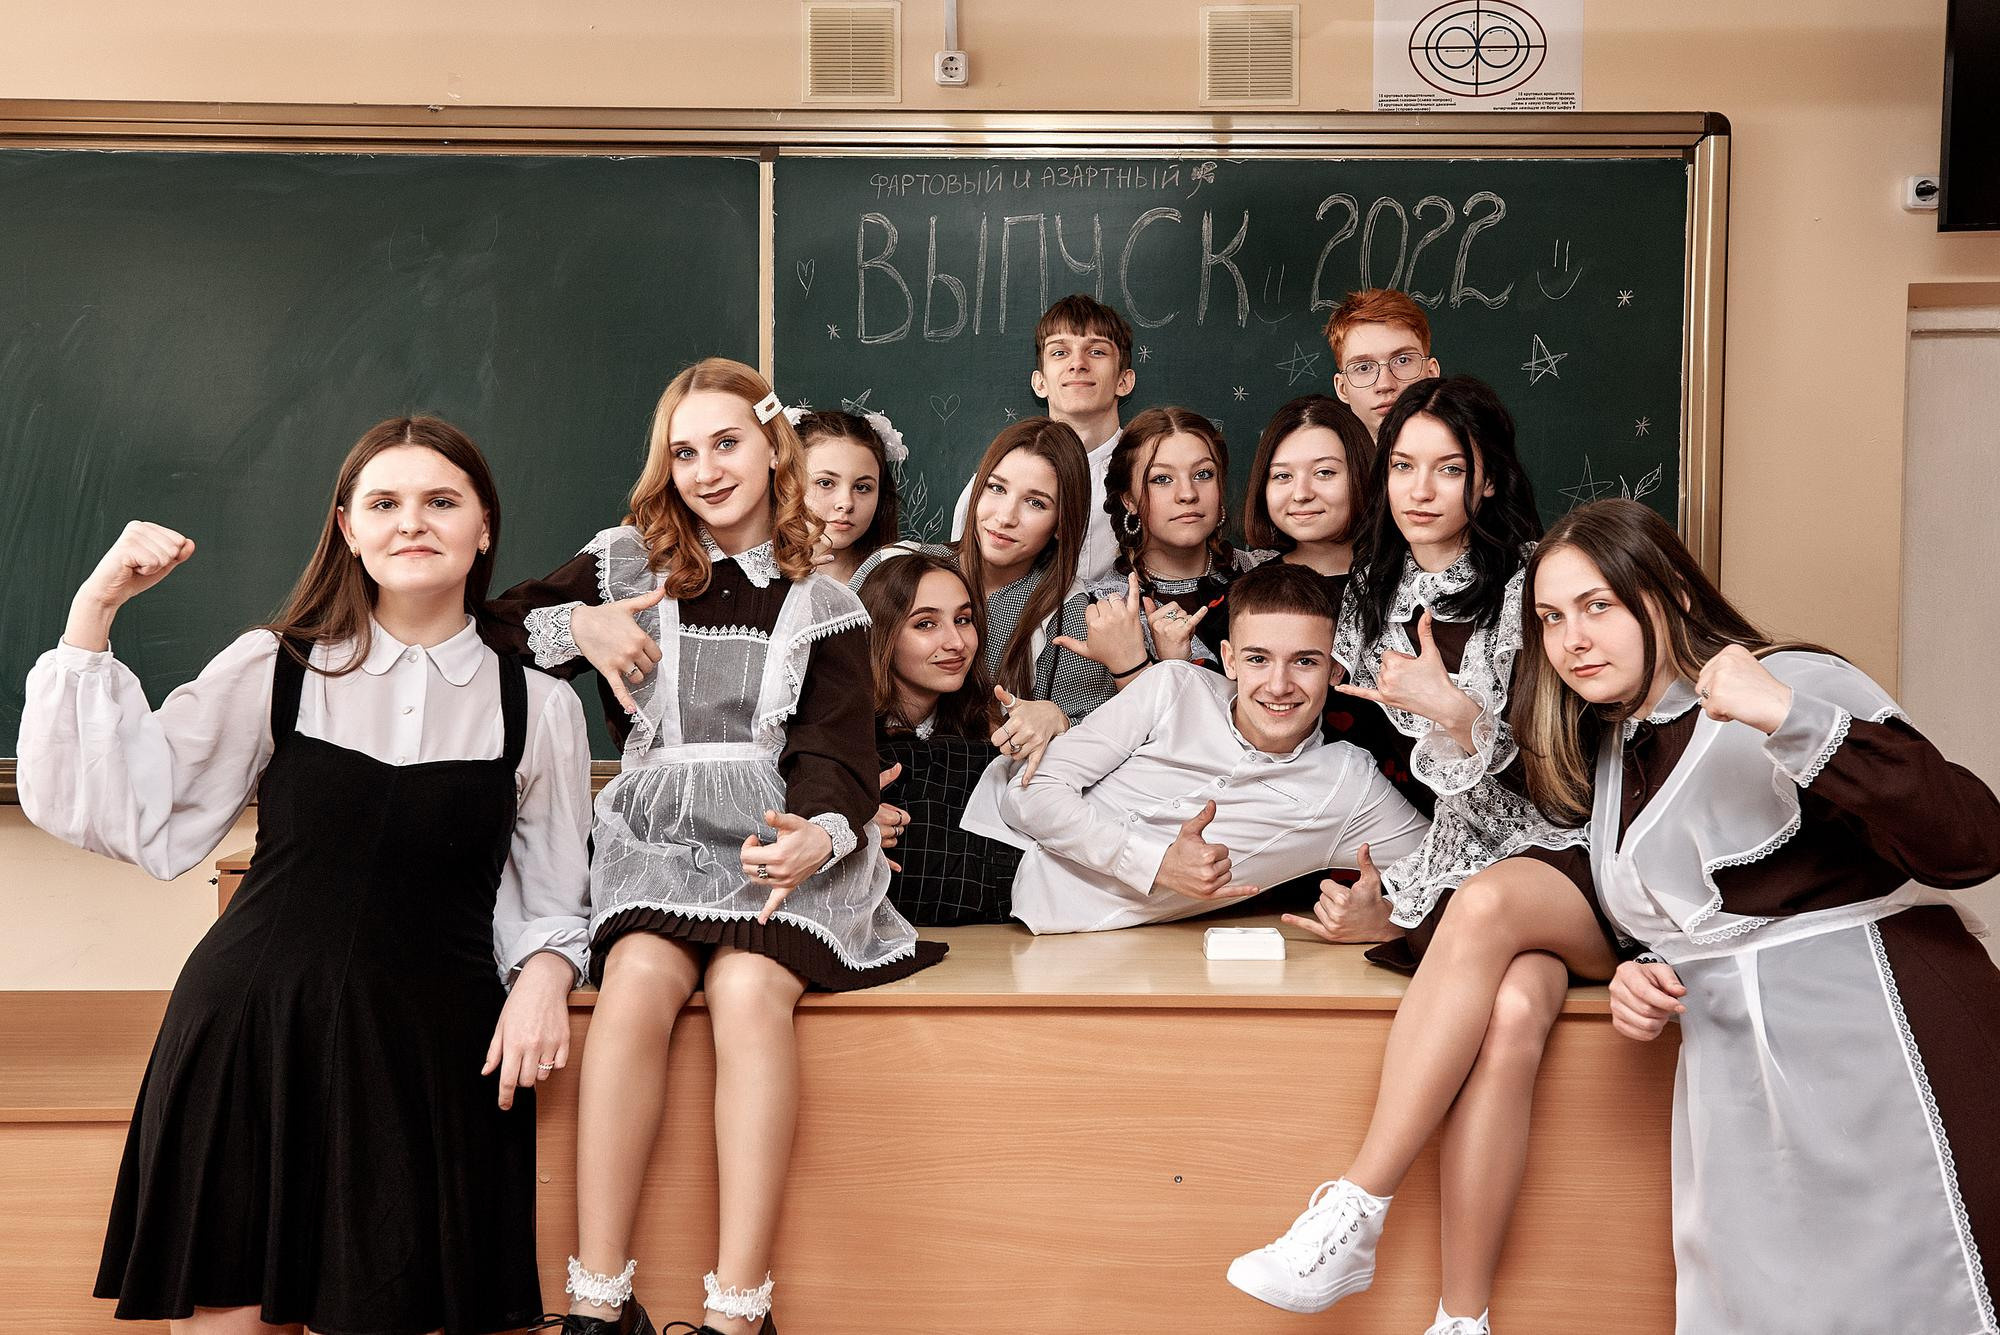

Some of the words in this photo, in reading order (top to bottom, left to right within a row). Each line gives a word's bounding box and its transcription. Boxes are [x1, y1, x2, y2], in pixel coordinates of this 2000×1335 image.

[869, 164, 1003, 199] ФАРТОВЫЙ
[1040, 164, 1181, 192] АЗАРТНЫЙ
[857, 207, 1250, 344] ВЫПУСК
[1310, 191, 1515, 312] 2022
